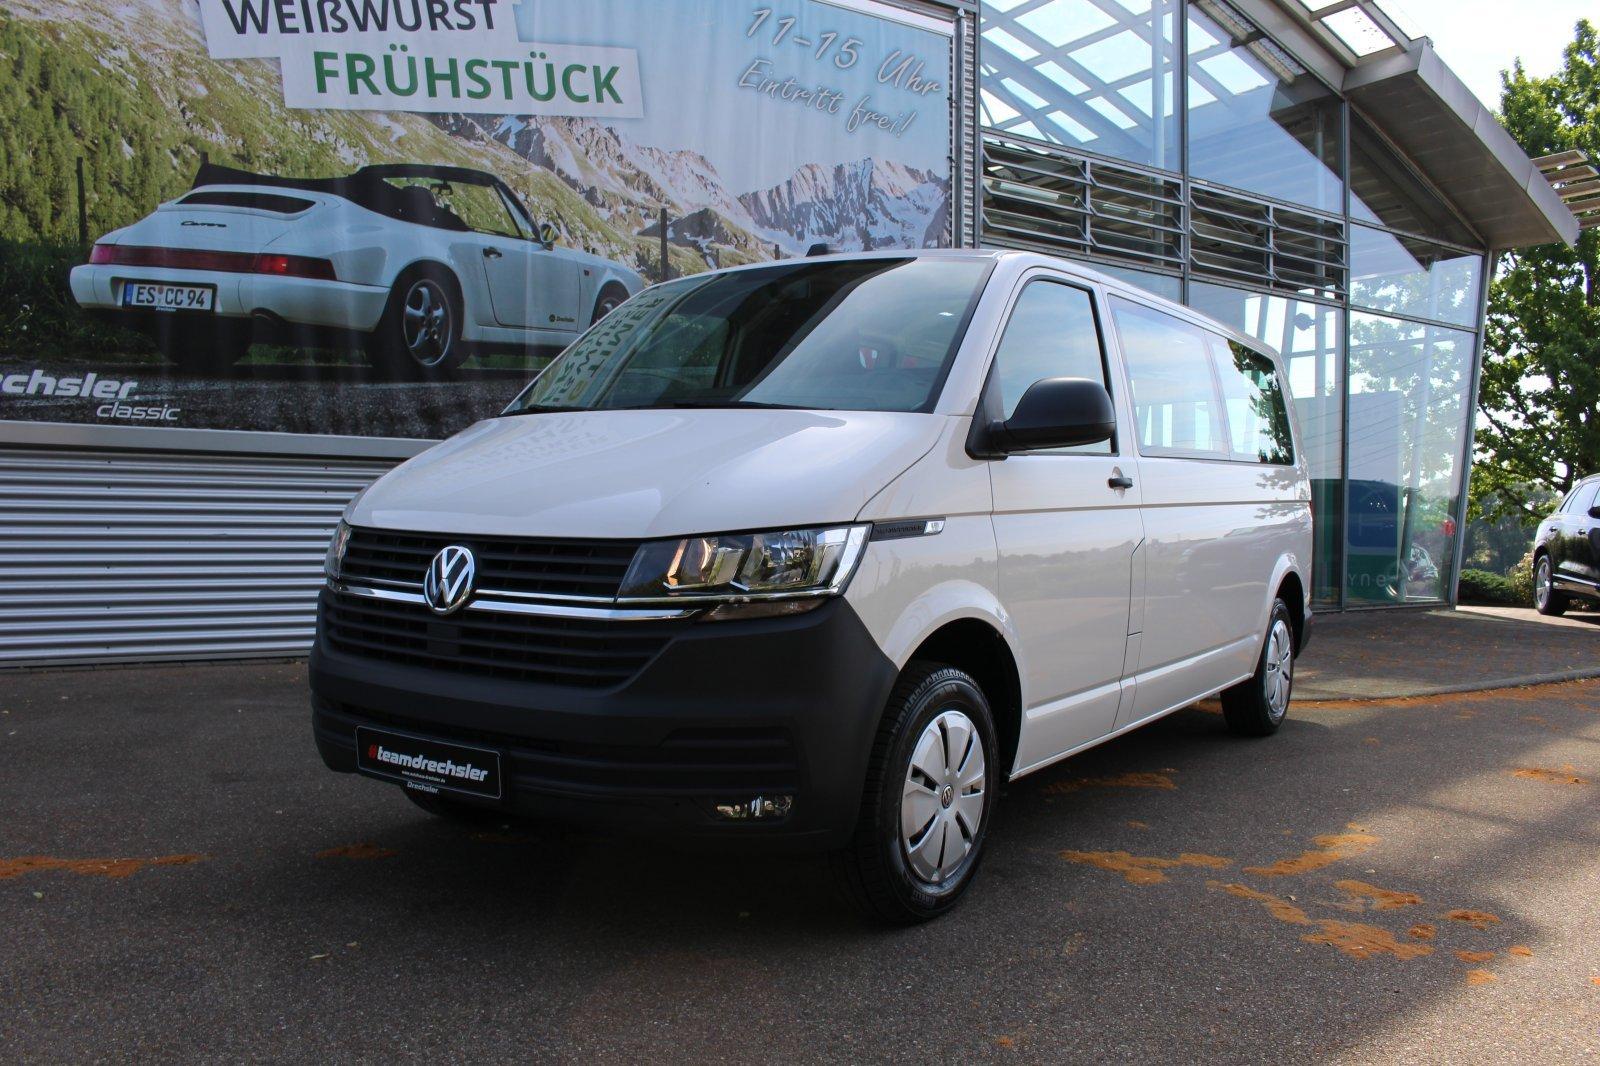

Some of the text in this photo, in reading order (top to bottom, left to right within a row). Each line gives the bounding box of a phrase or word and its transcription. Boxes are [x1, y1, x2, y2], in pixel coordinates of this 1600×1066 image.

[222, 0, 497, 35] WEIßWURST
[747, 8, 941, 96] 11-15 Uhr
[313, 43, 624, 105] FRÜHSTÜCK
[738, 58, 918, 138] Eintritt frei!
[135, 285, 206, 308] ES CC 94
[0, 369, 139, 401] chsler.
[96, 401, 182, 421] classic
[368, 744, 488, 782] #teamdrechsler
